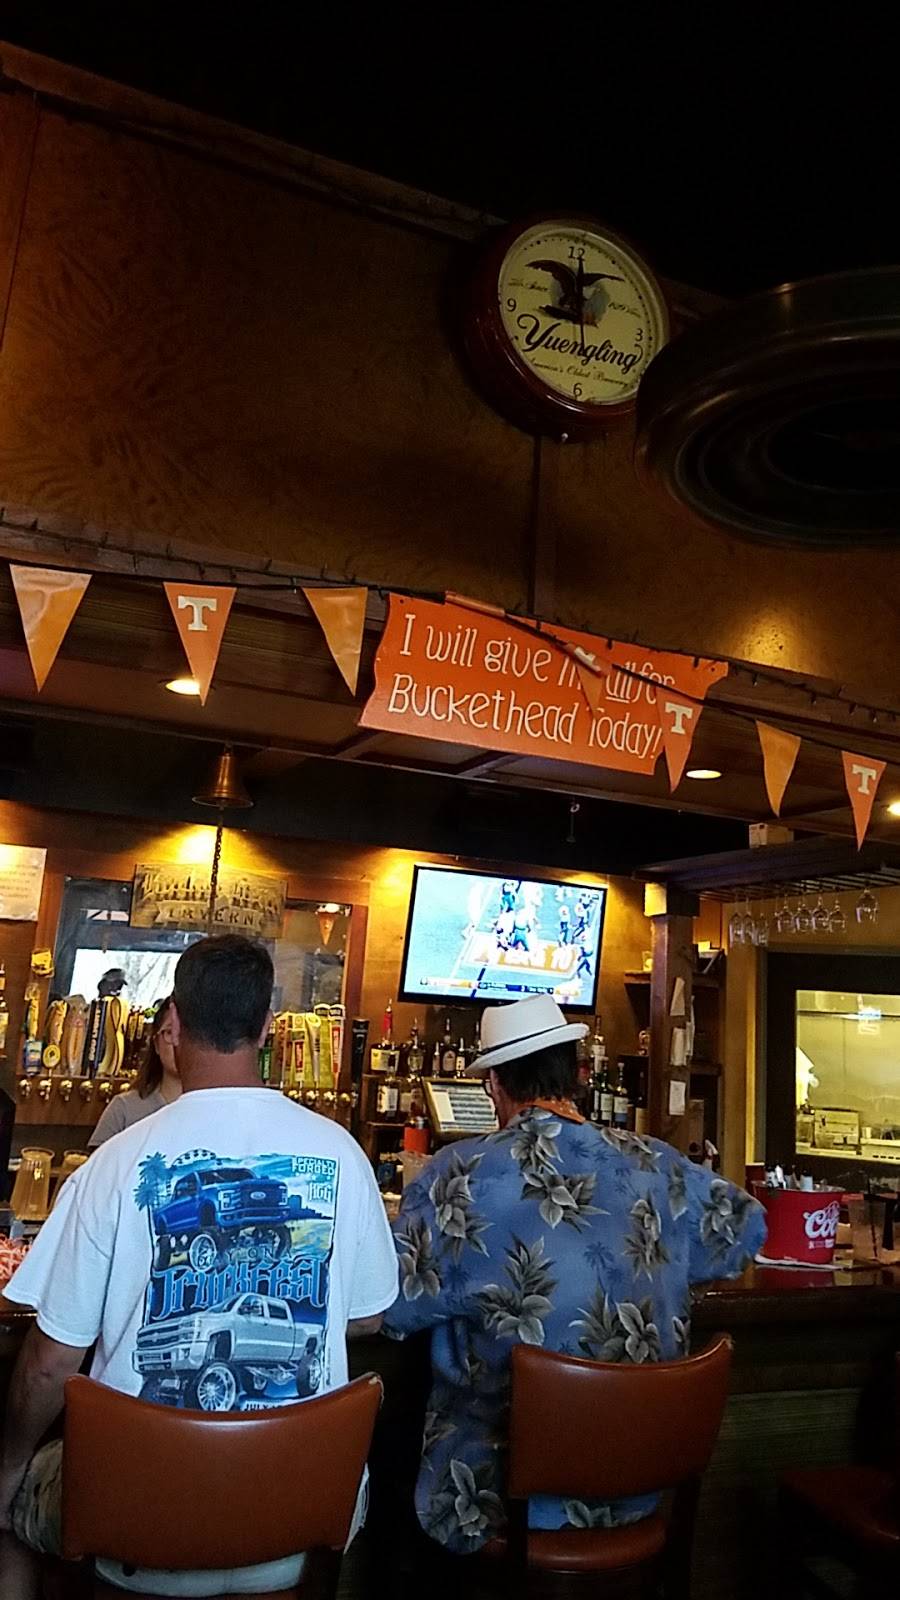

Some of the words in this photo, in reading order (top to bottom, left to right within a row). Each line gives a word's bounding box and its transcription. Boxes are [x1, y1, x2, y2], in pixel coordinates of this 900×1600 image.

[568, 246, 586, 262] 12
[506, 298, 517, 312] 9
[517, 313, 643, 375] Yuengling
[635, 328, 643, 341] 3
[573, 382, 583, 396] 6
[177, 595, 217, 632] T
[400, 613, 416, 656] I
[426, 625, 478, 668] will
[484, 637, 552, 682] give
[388, 673, 580, 745] Buckethead
[664, 701, 694, 735] T
[852, 763, 878, 795] T
